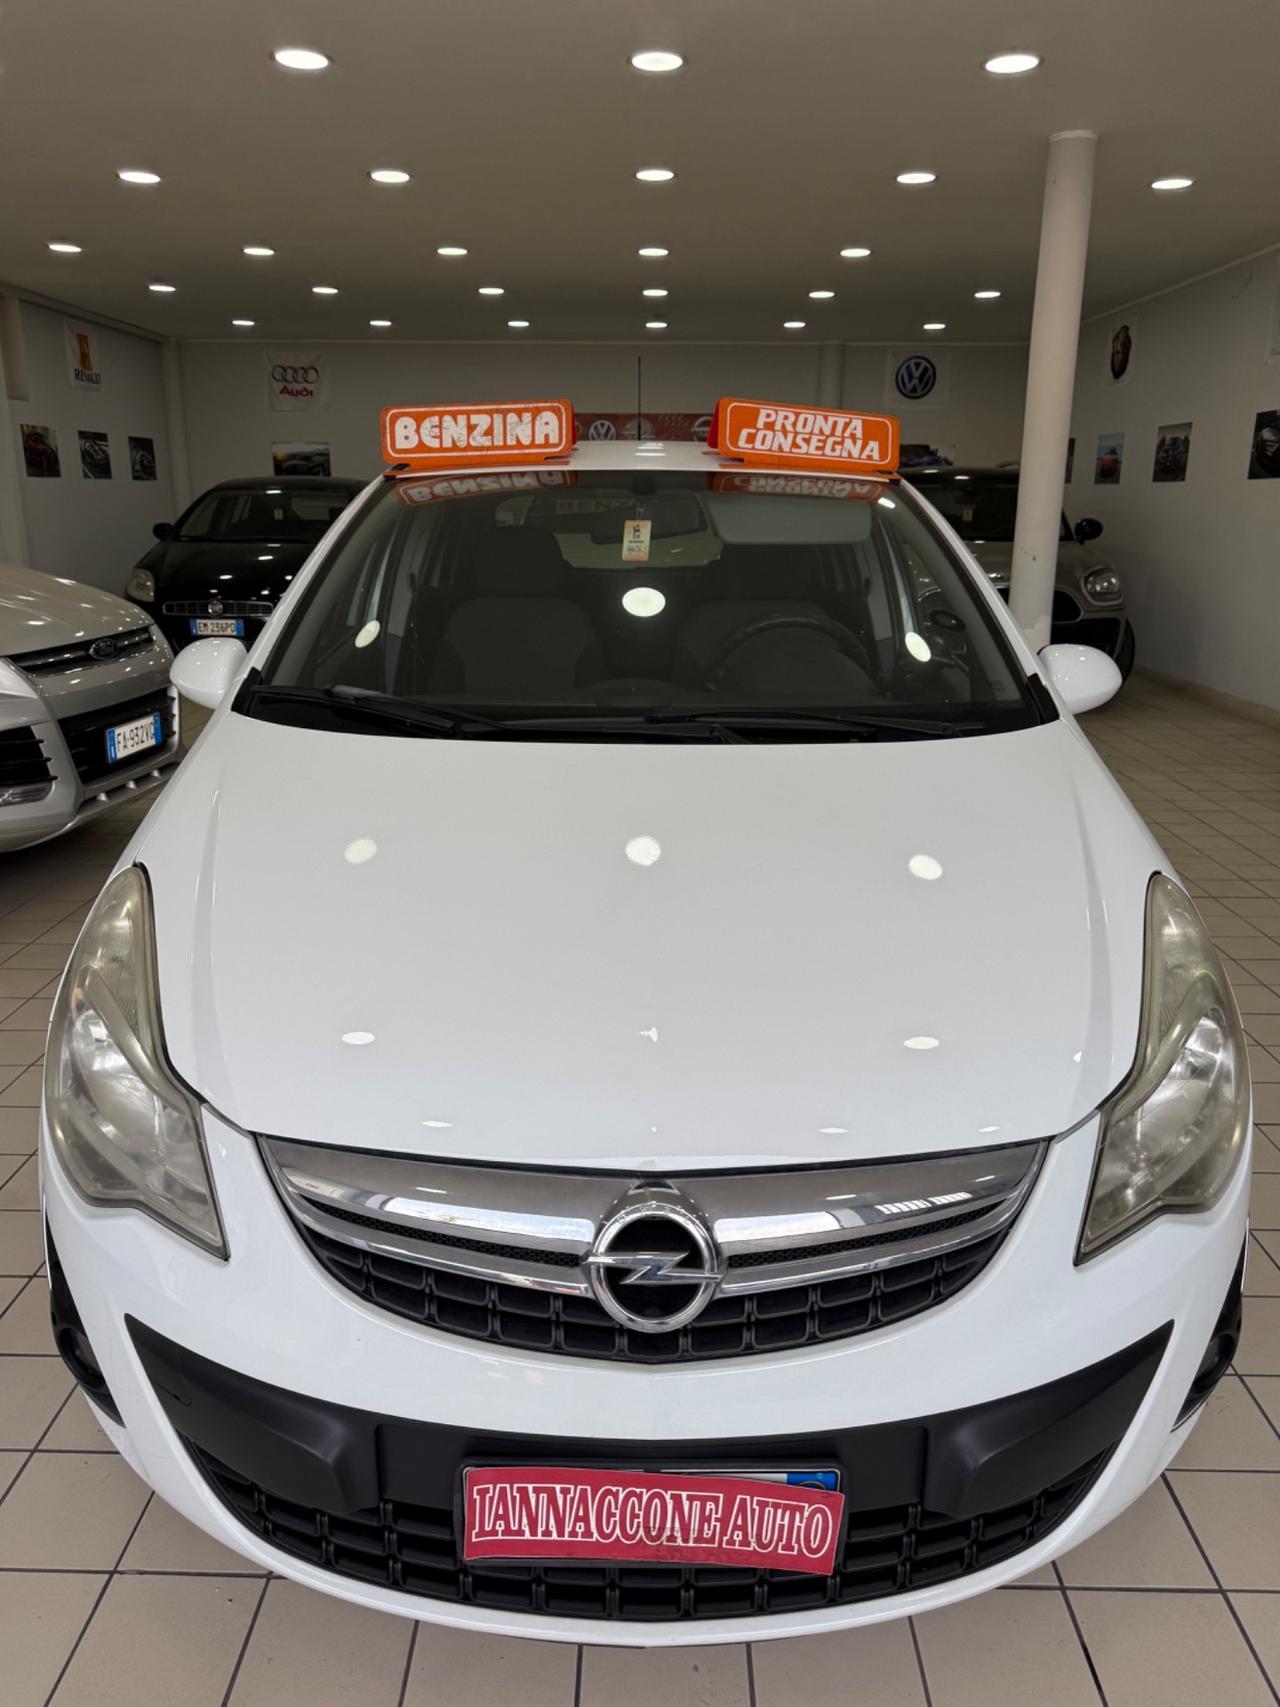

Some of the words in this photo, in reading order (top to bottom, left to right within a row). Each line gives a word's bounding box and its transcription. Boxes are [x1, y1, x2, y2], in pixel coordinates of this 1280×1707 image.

[394, 411, 560, 450] BENZINA
[756, 408, 864, 439] PRONTA
[737, 428, 881, 461] CONSEGNA
[471, 1483, 724, 1549] IANNACCONE
[723, 1494, 833, 1559] AUTO
